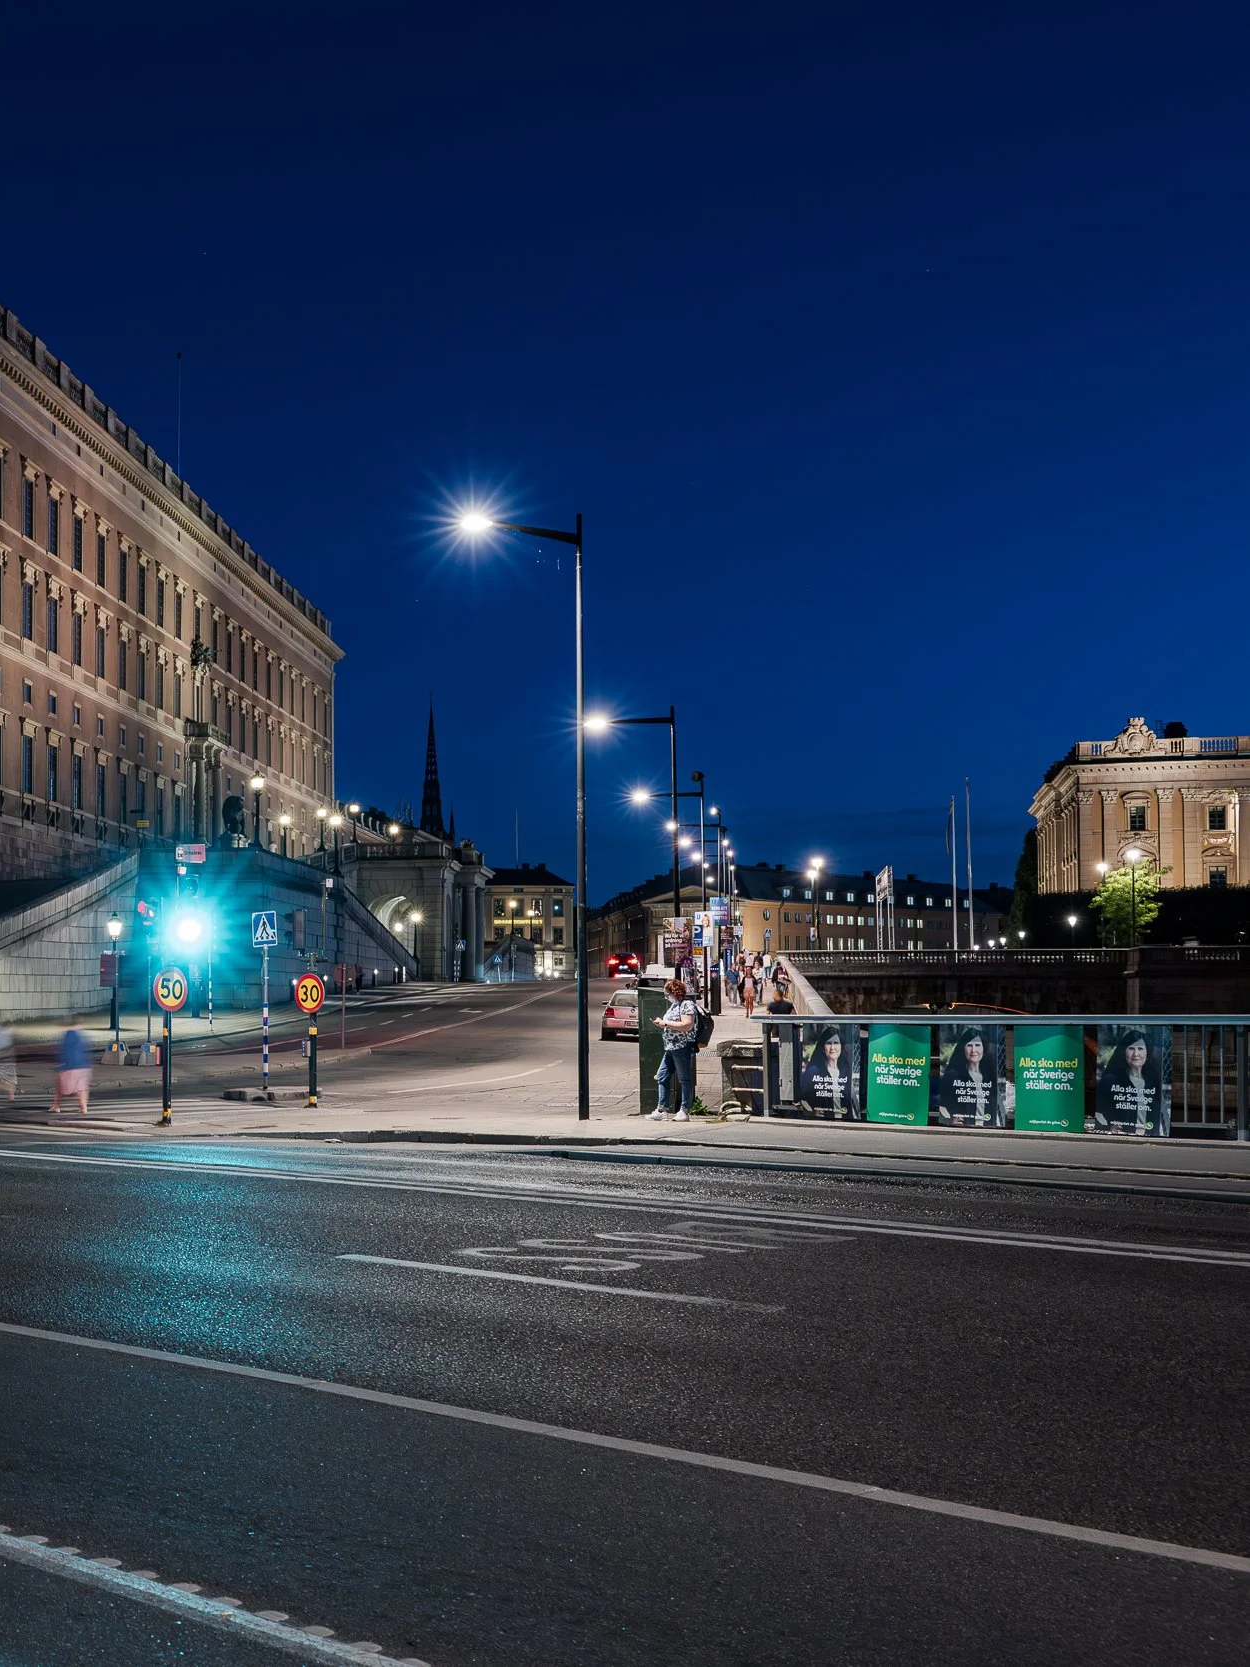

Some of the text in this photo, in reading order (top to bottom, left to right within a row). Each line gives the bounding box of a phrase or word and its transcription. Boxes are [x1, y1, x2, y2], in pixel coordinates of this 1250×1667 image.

[692, 926, 701, 938] P
[160, 978, 183, 999] 50
[300, 984, 320, 1002] 30
[872, 1053, 926, 1066] Alla ska med
[1020, 1057, 1078, 1068] Alla ska med
[875, 1064, 922, 1078] när Sverige
[1024, 1068, 1074, 1081] när Sverige
[876, 1075, 901, 1085] ställer
[1025, 1080, 1053, 1090] ställer
